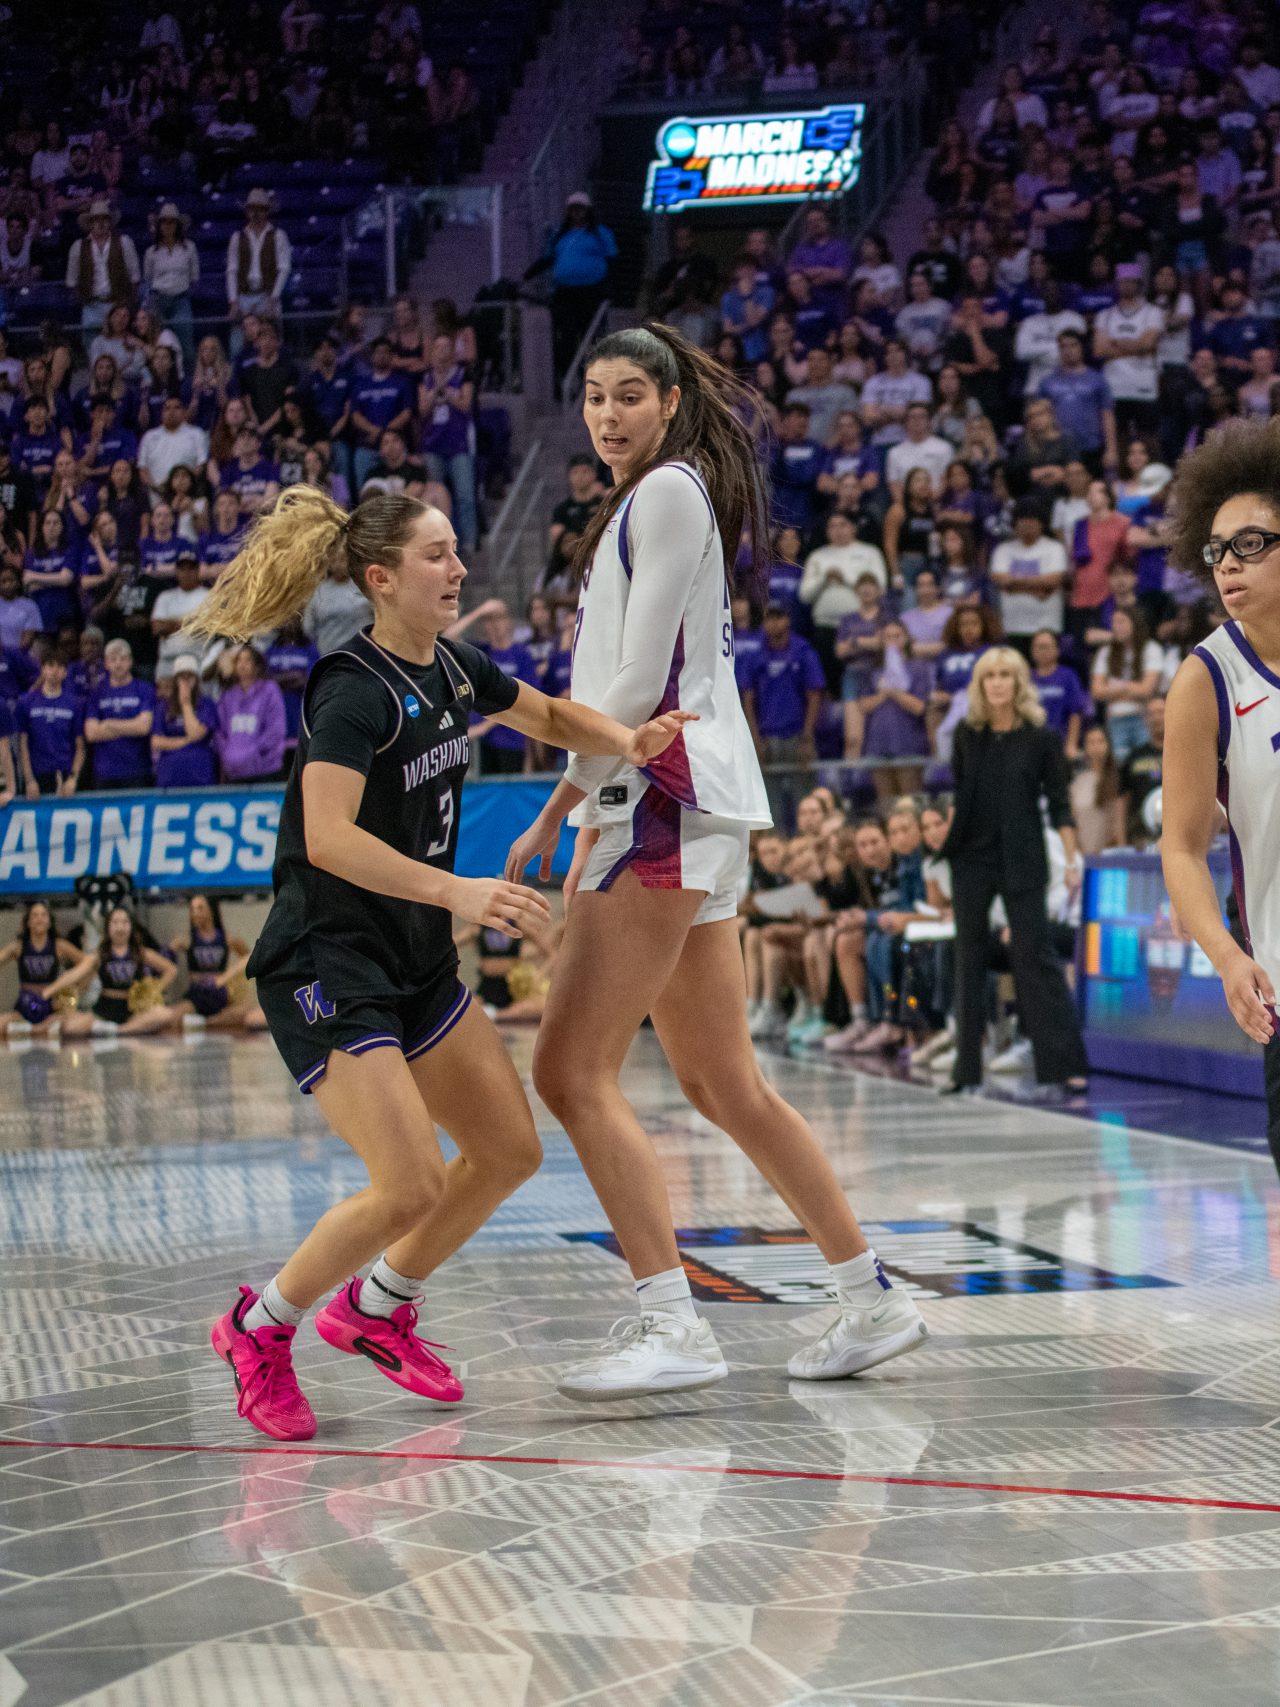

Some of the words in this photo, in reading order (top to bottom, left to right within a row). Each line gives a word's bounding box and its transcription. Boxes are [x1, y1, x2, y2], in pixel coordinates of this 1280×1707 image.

[693, 119, 804, 158] MARCH
[0, 801, 281, 880] ADNESS
[426, 788, 455, 857] 3
[294, 980, 337, 1025] W
